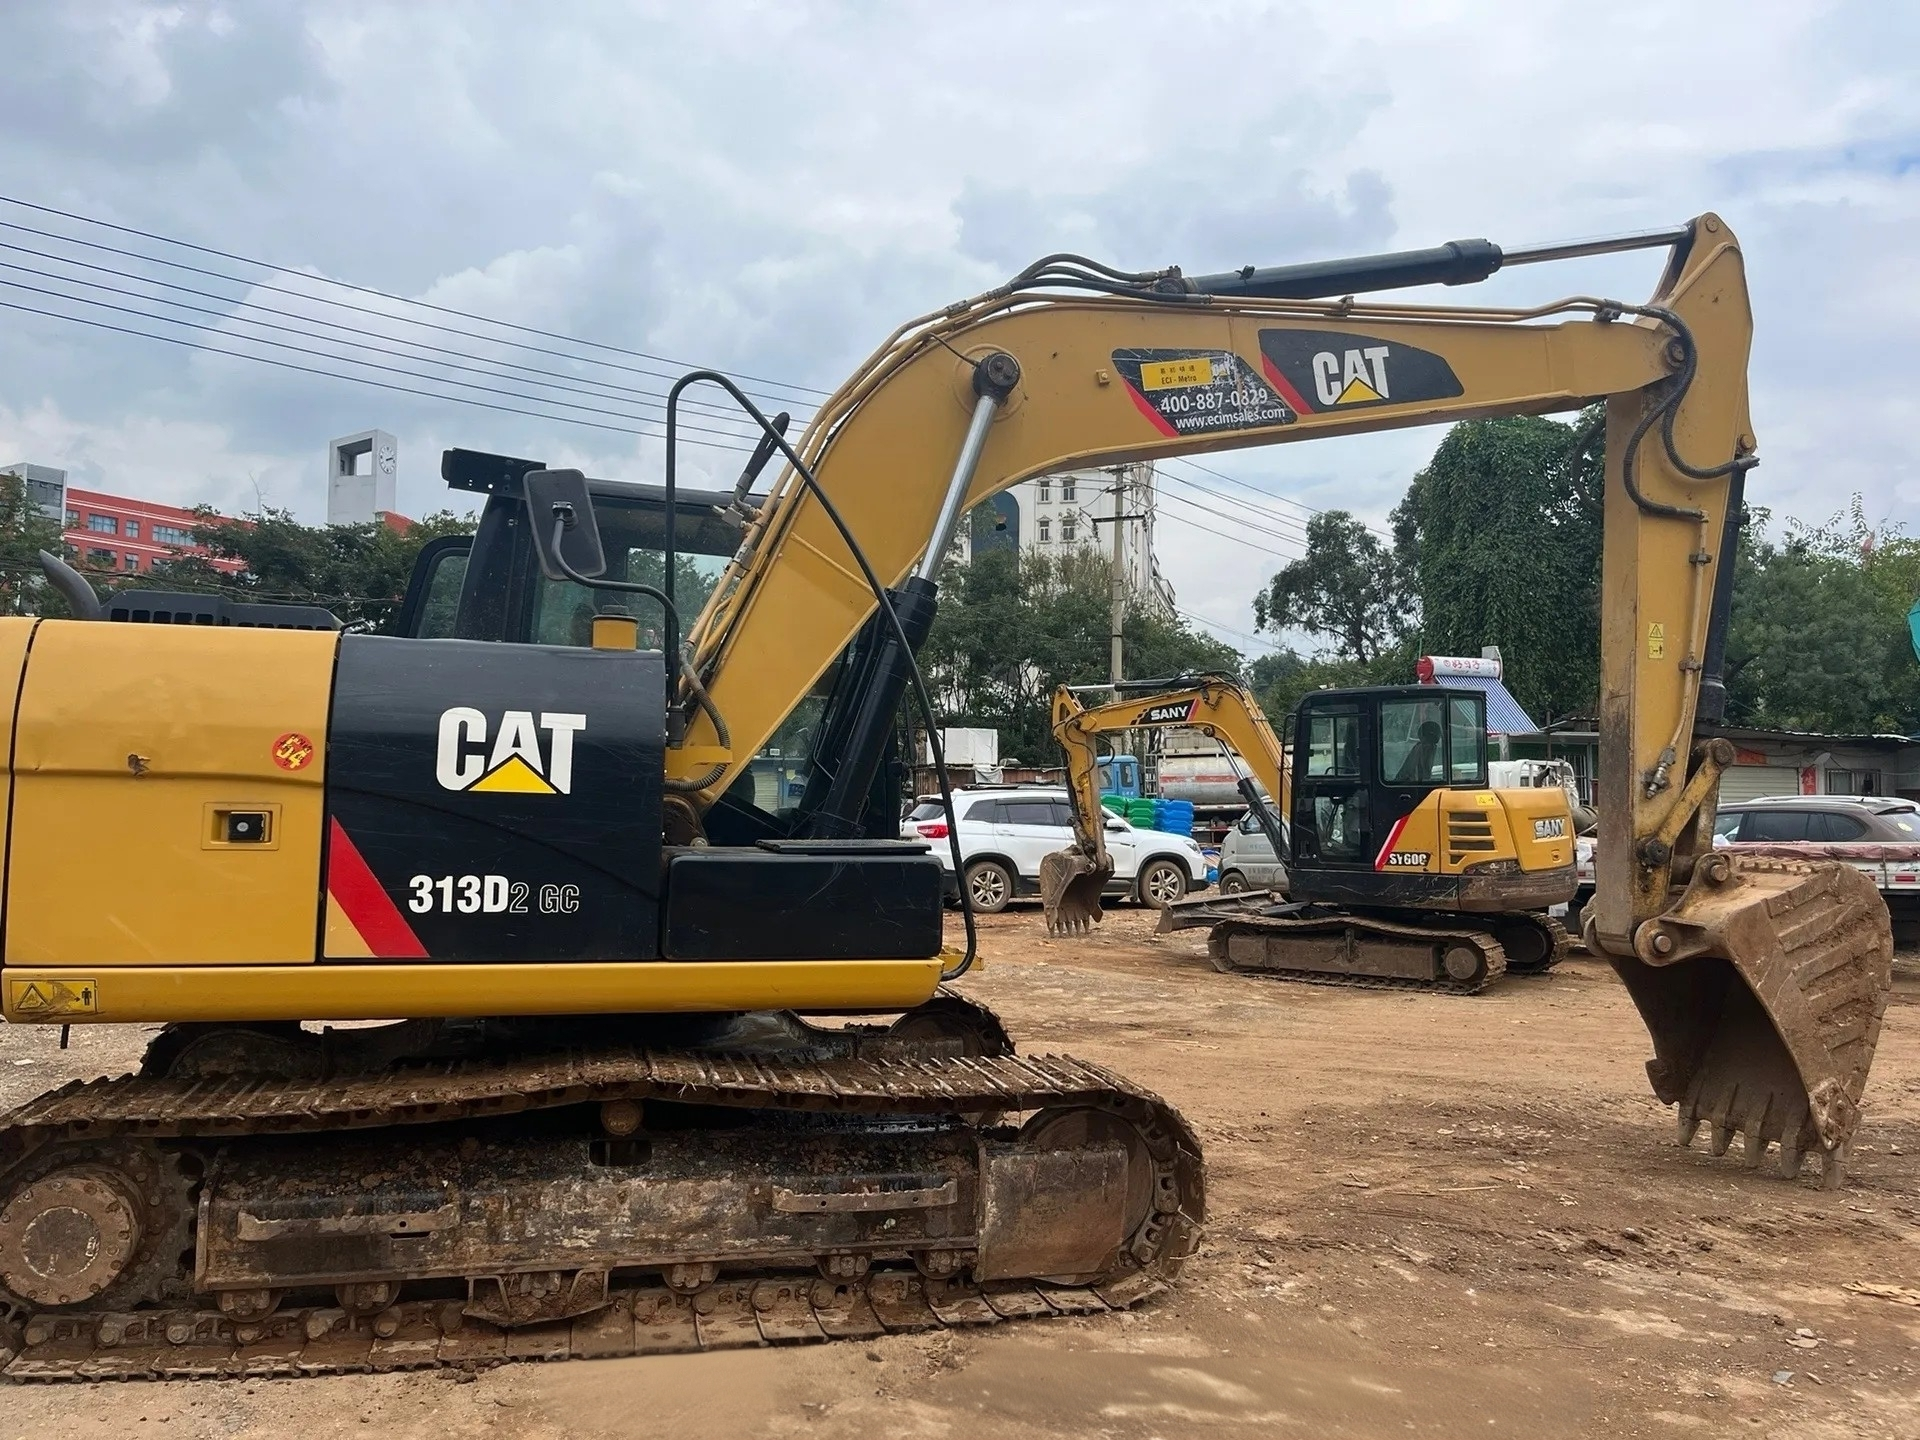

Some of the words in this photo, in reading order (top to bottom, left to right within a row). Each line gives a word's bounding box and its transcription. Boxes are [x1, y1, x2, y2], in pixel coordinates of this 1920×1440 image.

[1312, 346, 1390, 406] CAT
[1150, 705, 1188, 721] SANY
[436, 706, 587, 795] CAT
[1533, 818, 1566, 839] SANY
[539, 884, 580, 914] GC
